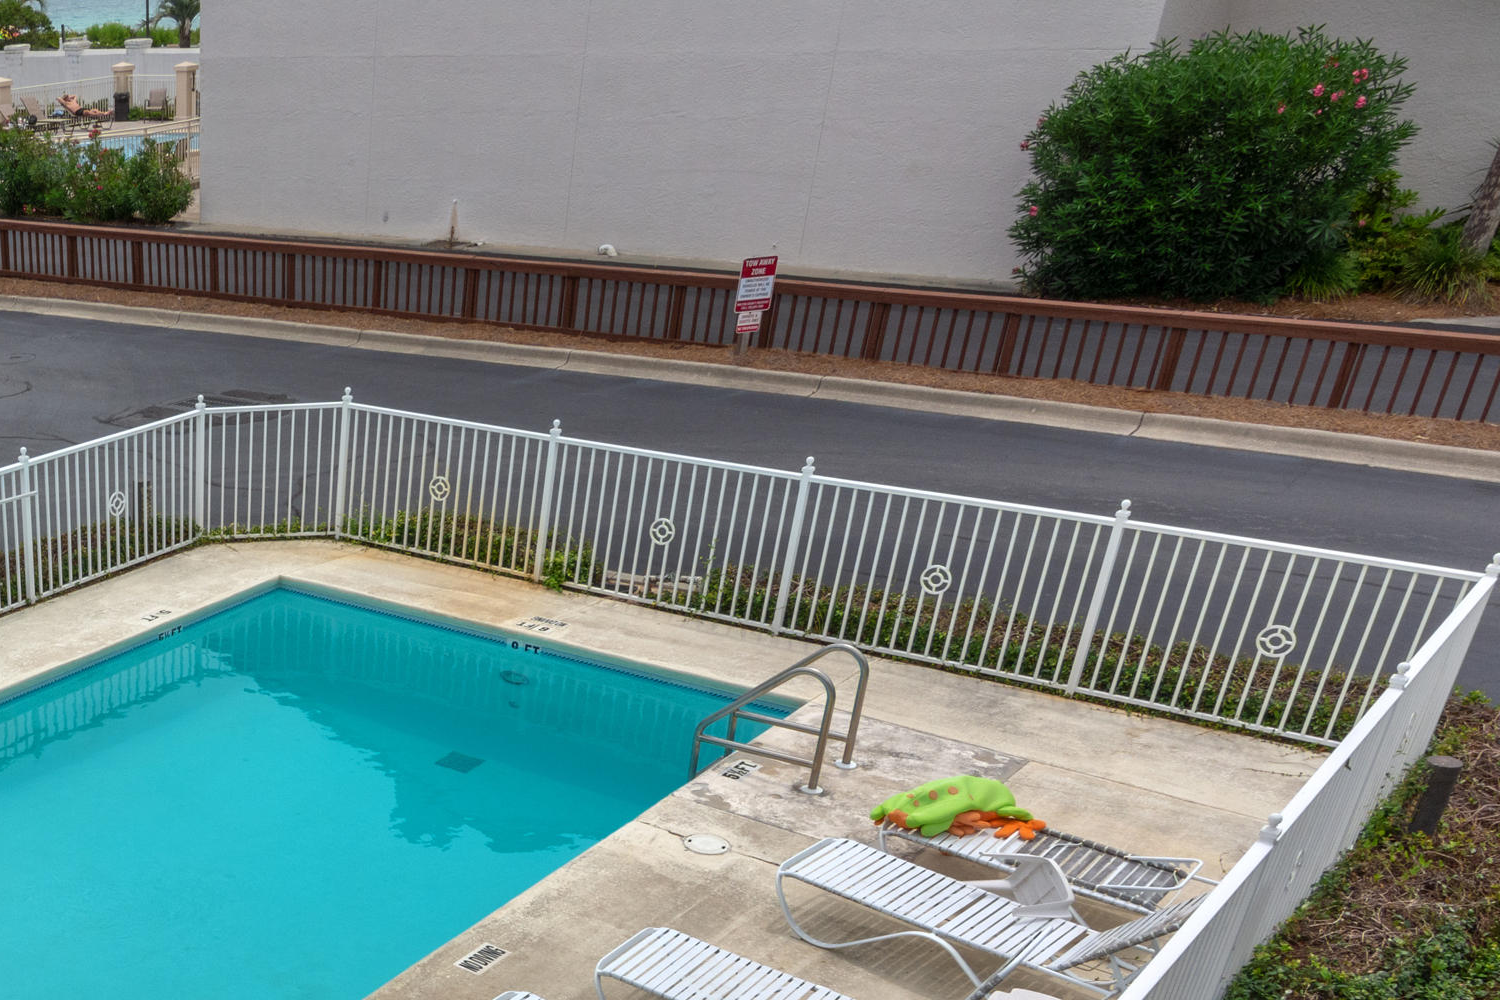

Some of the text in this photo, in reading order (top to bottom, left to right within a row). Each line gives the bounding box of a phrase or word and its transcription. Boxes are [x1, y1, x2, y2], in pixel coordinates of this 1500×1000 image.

[746, 258, 775, 267] TOW AWAY
[458, 946, 507, 972] NO DIVING
